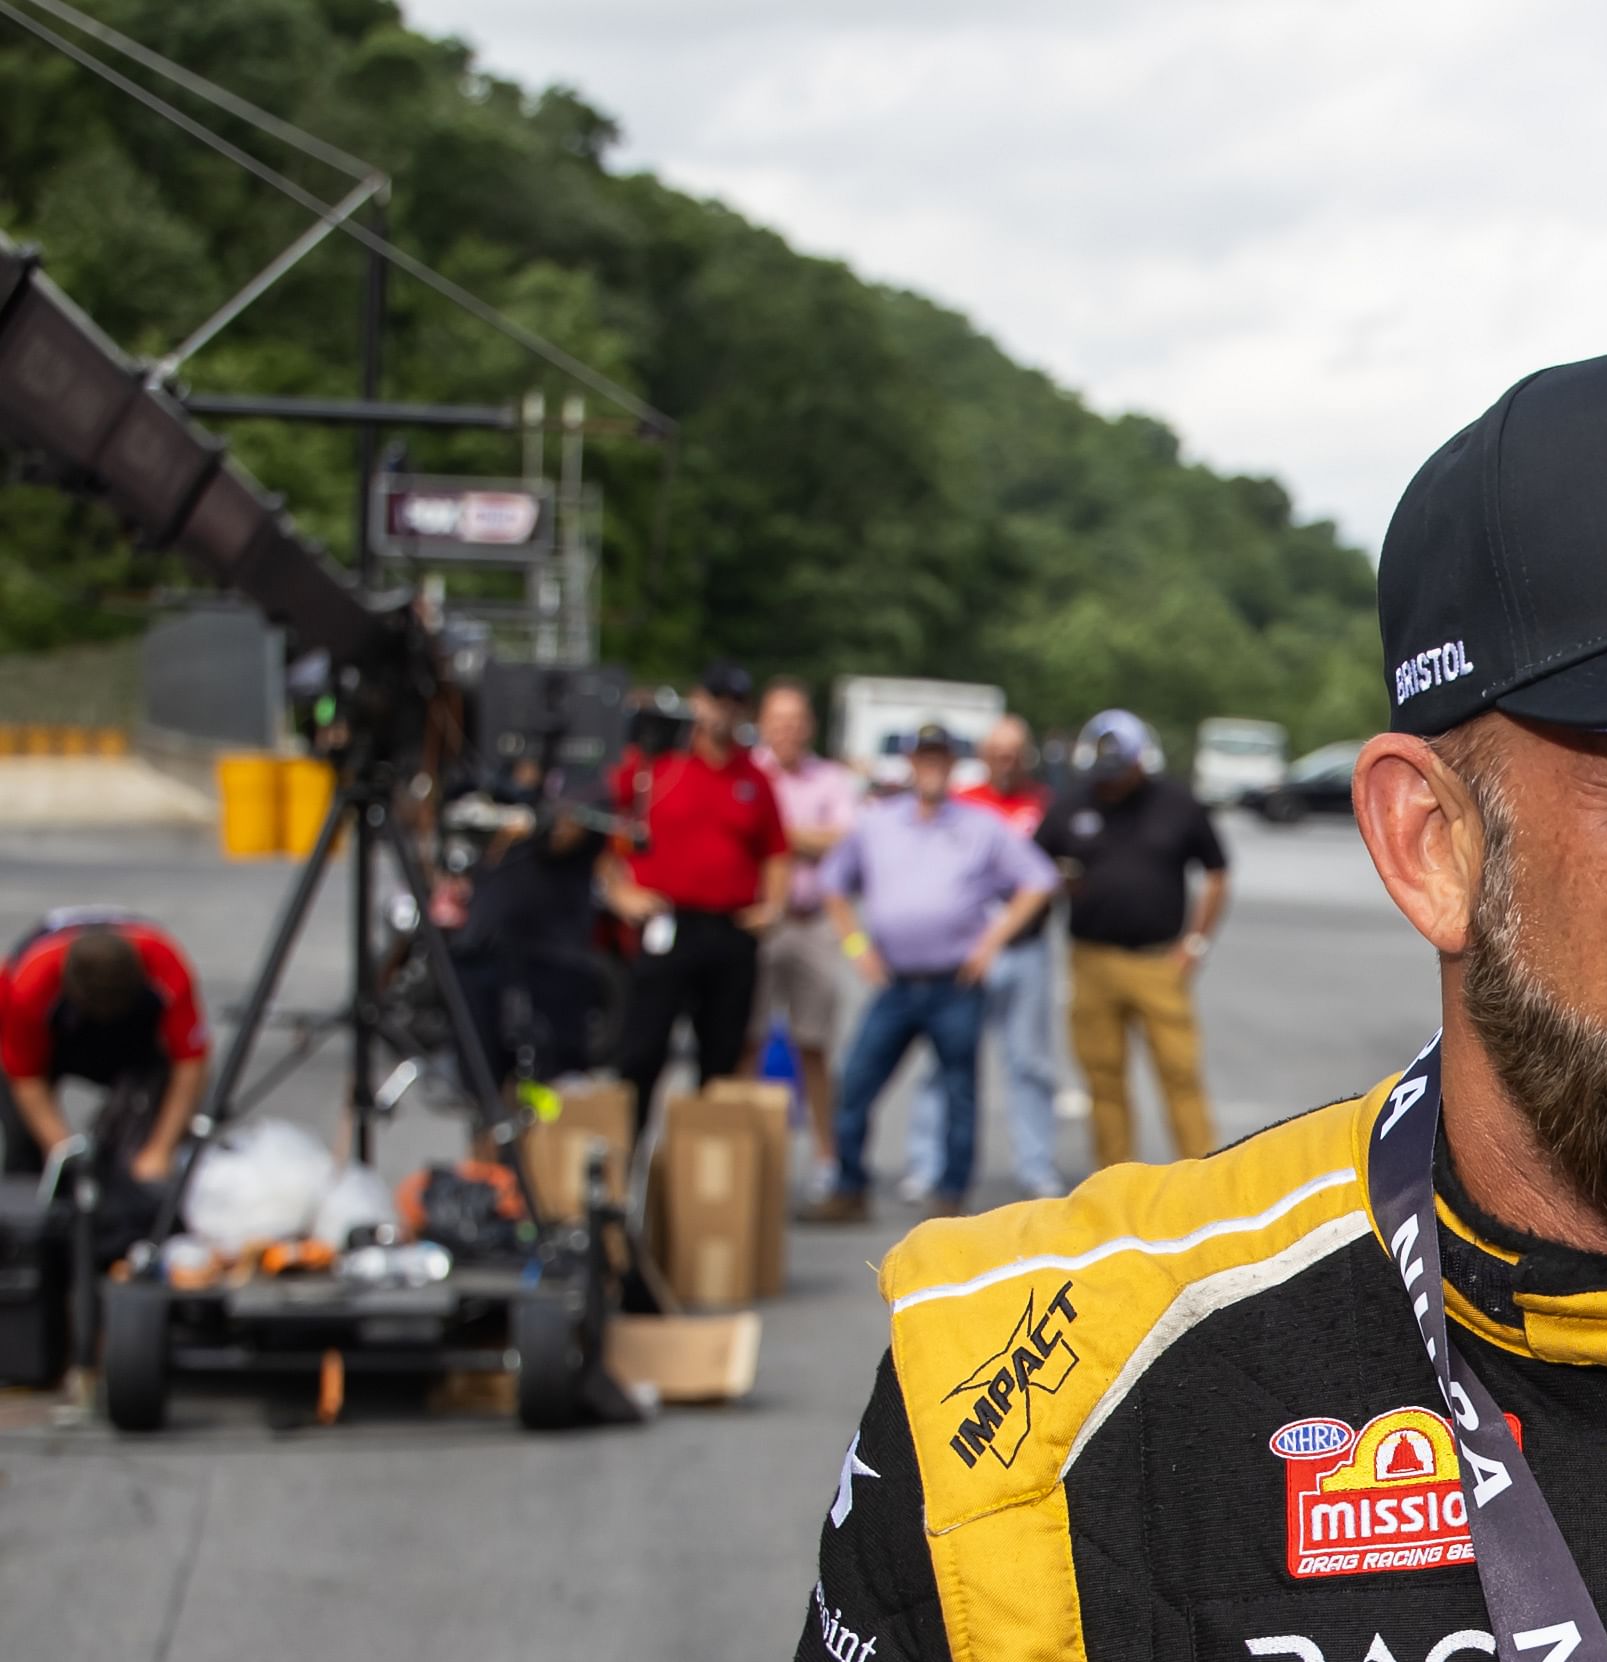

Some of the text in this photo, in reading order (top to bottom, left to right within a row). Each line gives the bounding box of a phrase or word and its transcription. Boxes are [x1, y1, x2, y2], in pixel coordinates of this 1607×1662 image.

[1396, 640, 1474, 706] BRISTOL
[949, 1281, 1079, 1469] IMPACT
[1283, 1425, 1346, 1451] NHRA
[1310, 1491, 1468, 1541] MISSIO
[1298, 1554, 1360, 1574] DRAG
[1363, 1544, 1441, 1570] RACING
